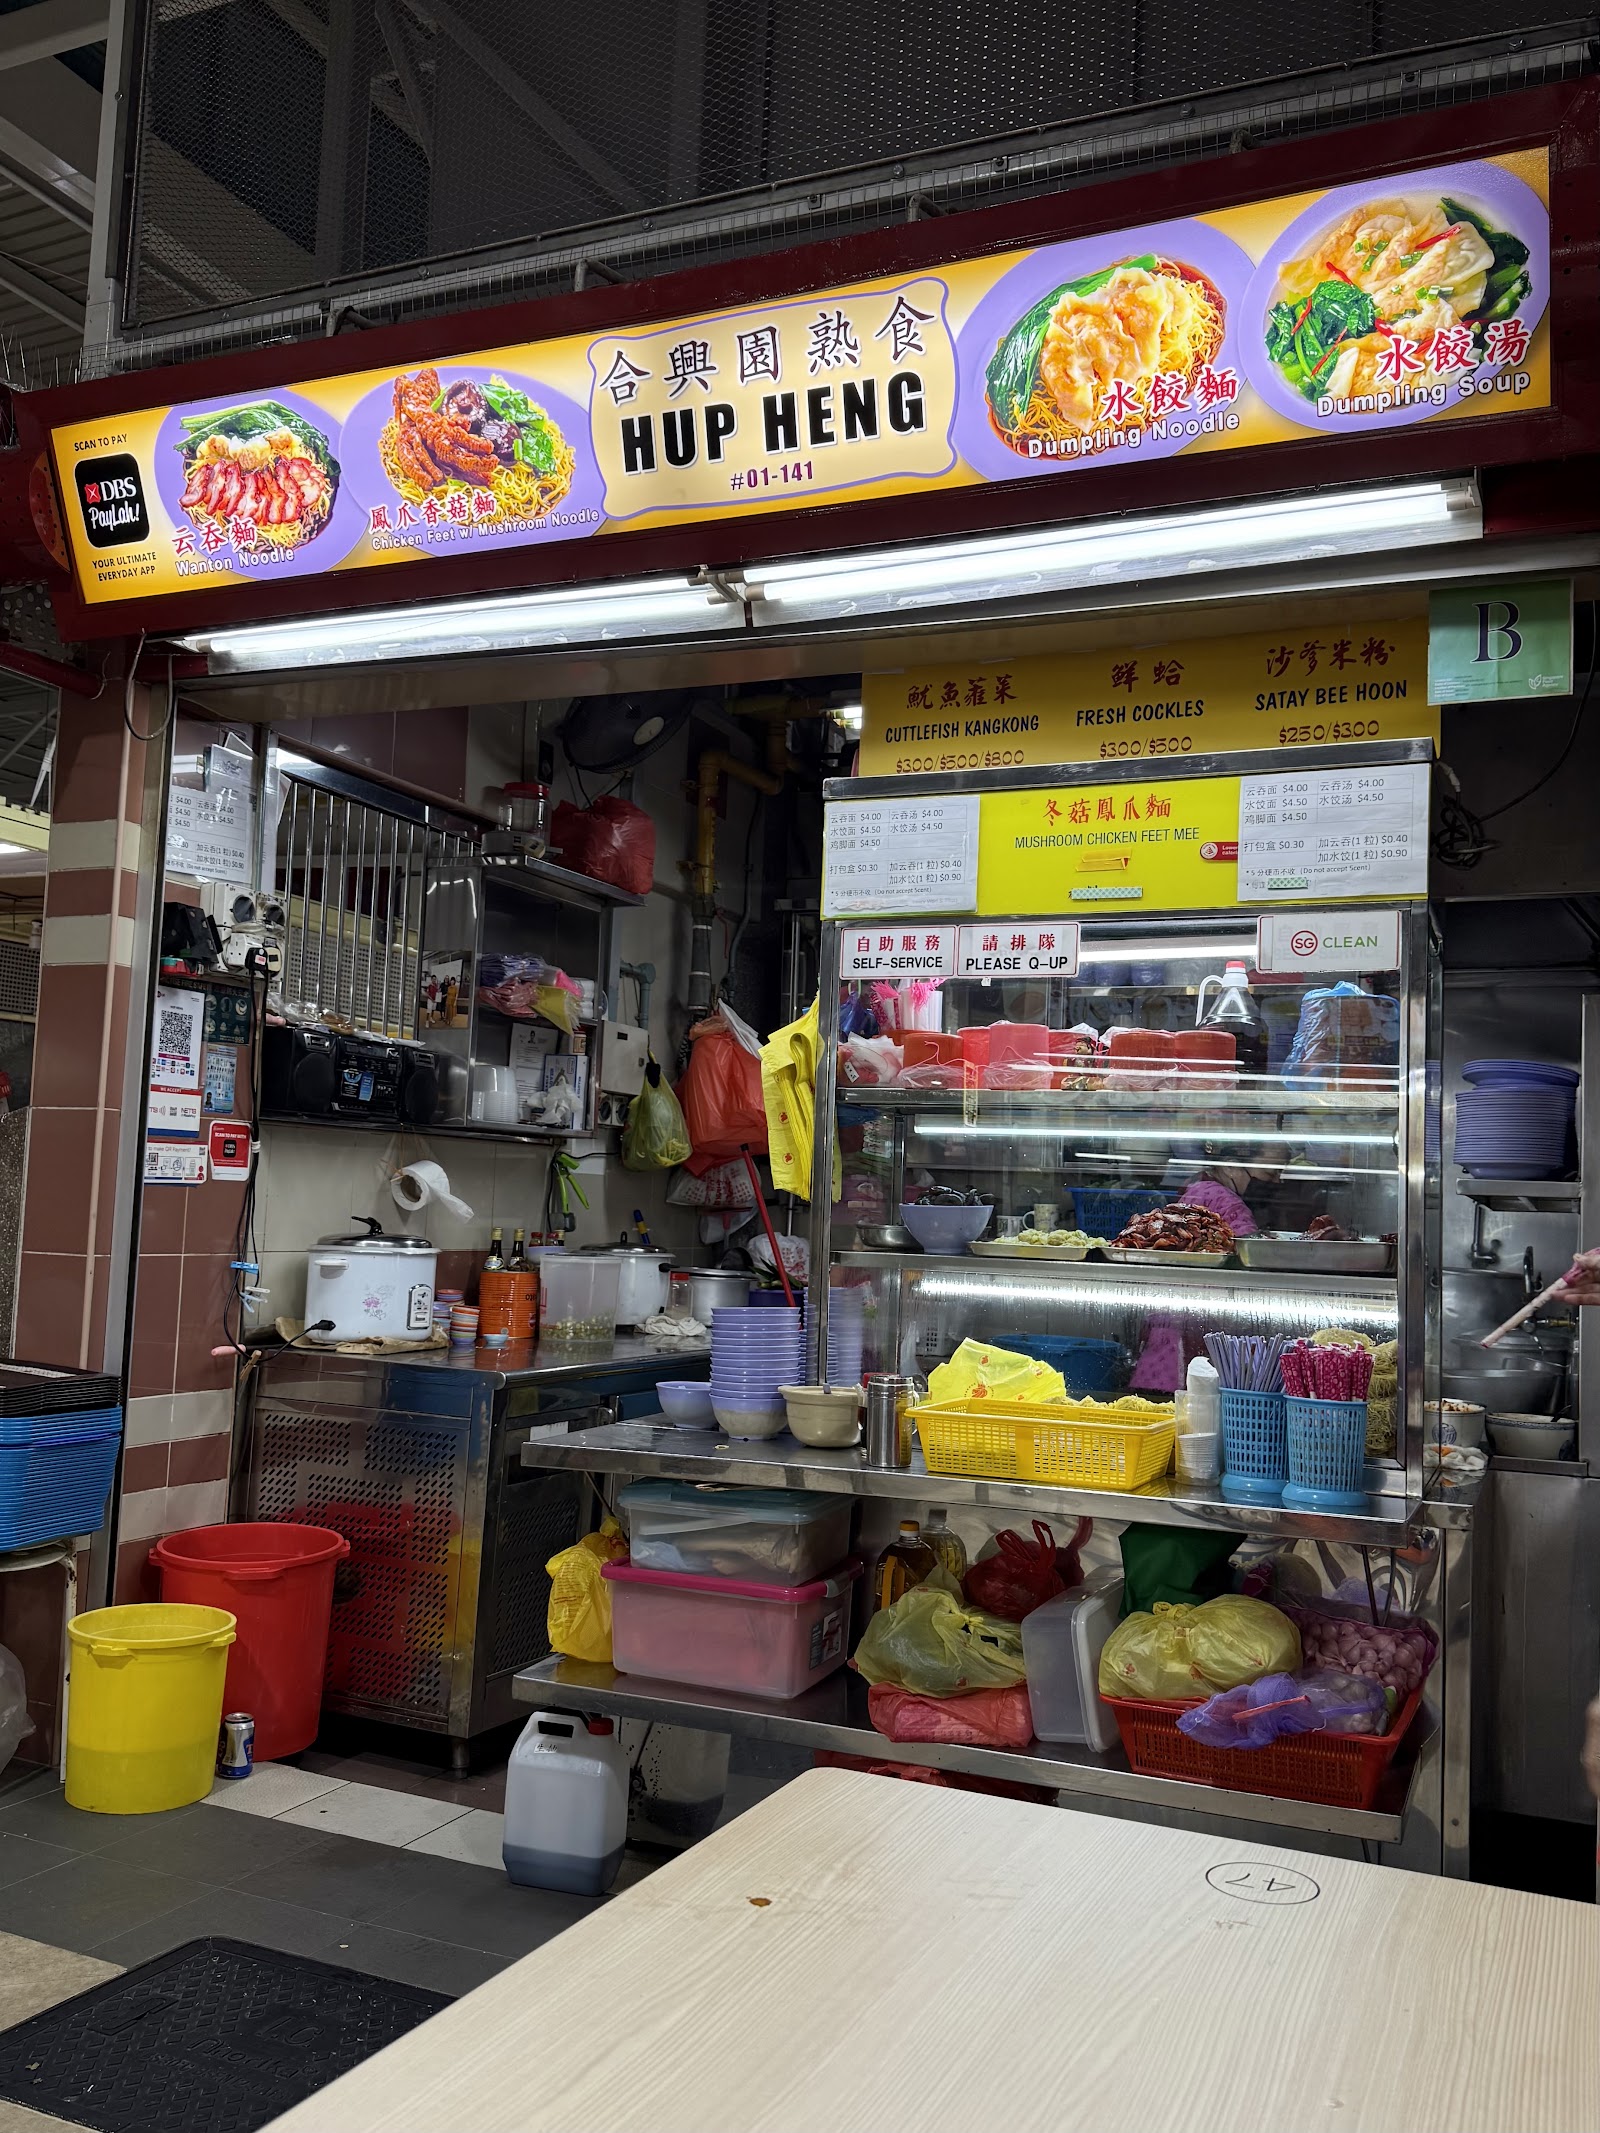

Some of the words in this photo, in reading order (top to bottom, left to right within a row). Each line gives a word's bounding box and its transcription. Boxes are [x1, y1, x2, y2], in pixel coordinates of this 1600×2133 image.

[600, 296, 935, 404] 合興園熟食
[1376, 319, 1529, 381] 水餃湯
[1102, 367, 1238, 422] 水餃麵
[1317, 383, 1446, 417] Dumpling
[1458, 372, 1531, 397] Soup
[621, 402, 736, 474] HUP
[762, 371, 926, 453] HENG
[74, 440, 96, 451] SCAN
[98, 437, 109, 448] TO
[112, 434, 128, 445] PAY
[1028, 427, 1141, 458] Dumpling
[1152, 412, 1239, 440] Noodle
[730, 461, 813, 490] #01-141
[100, 476, 137, 502] DBS
[88, 501, 140, 531] PayLah!
[370, 491, 496, 531] 鳳爪香菇麵
[171, 517, 255, 555] 云吞麵
[372, 533, 423, 550] Chicken
[427, 529, 456, 543] Feet
[458, 526, 474, 539] w/
[478, 517, 546, 537] Mushroom
[551, 508, 600, 529] Noodle
[92, 558, 115, 569] YOUR
[116, 552, 156, 566] ULTIMATE
[175, 557, 233, 576] Wanton
[238, 548, 294, 568] Noodle
[98, 567, 138, 582] EVERYDAY
[140, 565, 156, 575] APP
[1470, 600, 1524, 664] B
[1266, 637, 1396, 677] 沙爹米粉
[1255, 688, 1309, 711] SATAY
[1316, 686, 1348, 705] BEE
[1356, 680, 1407, 701] HOON
[1076, 706, 1126, 726] FRESH
[1132, 700, 1204, 722] COCKLES
[886, 721, 959, 743] CUTTLEFISH
[965, 715, 1039, 736] KANGKONG
[1246, 785, 1277, 796] 云吞面
[1283, 784, 1308, 793] $4.00
[1320, 780, 1353, 791] 云吞汤
[1358, 779, 1384, 788] $4.00
[176, 797, 192, 805] $4.00
[1244, 799, 1277, 810] 水饺面
[1282, 798, 1308, 808] $4.50
[1319, 795, 1353, 806] 水饺汤
[1357, 793, 1384, 803] $4.50
[175, 807, 191, 816] $4.50
[830, 814, 856, 823] 云吞面
[861, 813, 882, 822] $4.00
[891, 810, 918, 820] 云吞汤
[922, 810, 943, 818] $4.00
[1043, 794, 1172, 826] 冬菇鳳爪麵
[1244, 814, 1276, 825] 鸡脚面
[1282, 812, 1307, 822] $4.50
[175, 819, 190, 828] $4.50
[830, 826, 856, 836] 水饺面
[860, 826, 881, 834] $4.50
[890, 823, 918, 833] 水饺汤
[921, 822, 943, 831] $4.50
[860, 839, 881, 848] $4.50
[1015, 833, 1083, 848] MUSHROOM
[1087, 830, 1136, 845] CHICKEN
[1141, 828, 1170, 842] FEET
[1174, 827, 1200, 840] MEE
[1244, 841, 1276, 852] 打包盒
[1279, 840, 1304, 850] $0.30
[1381, 834, 1408, 844] $0.40
[1380, 849, 1407, 859] $0.90
[830, 864, 856, 875] 打包盒
[858, 864, 878, 872] $0.30
[940, 860, 962, 868] $0.40
[1300, 867, 1312, 875] (Do
[1326, 865, 1348, 874] accept
[940, 873, 961, 881] $0.90
[857, 934, 941, 952] 自助服務
[982, 933, 1055, 950] 請排隊
[1294, 938, 1315, 949] SG
[1323, 935, 1378, 948] CLEAN
[852, 956, 943, 969] SELF-SERVICE
[966, 957, 1021, 971] PLEASE
[1029, 956, 1068, 970] Q-UP
